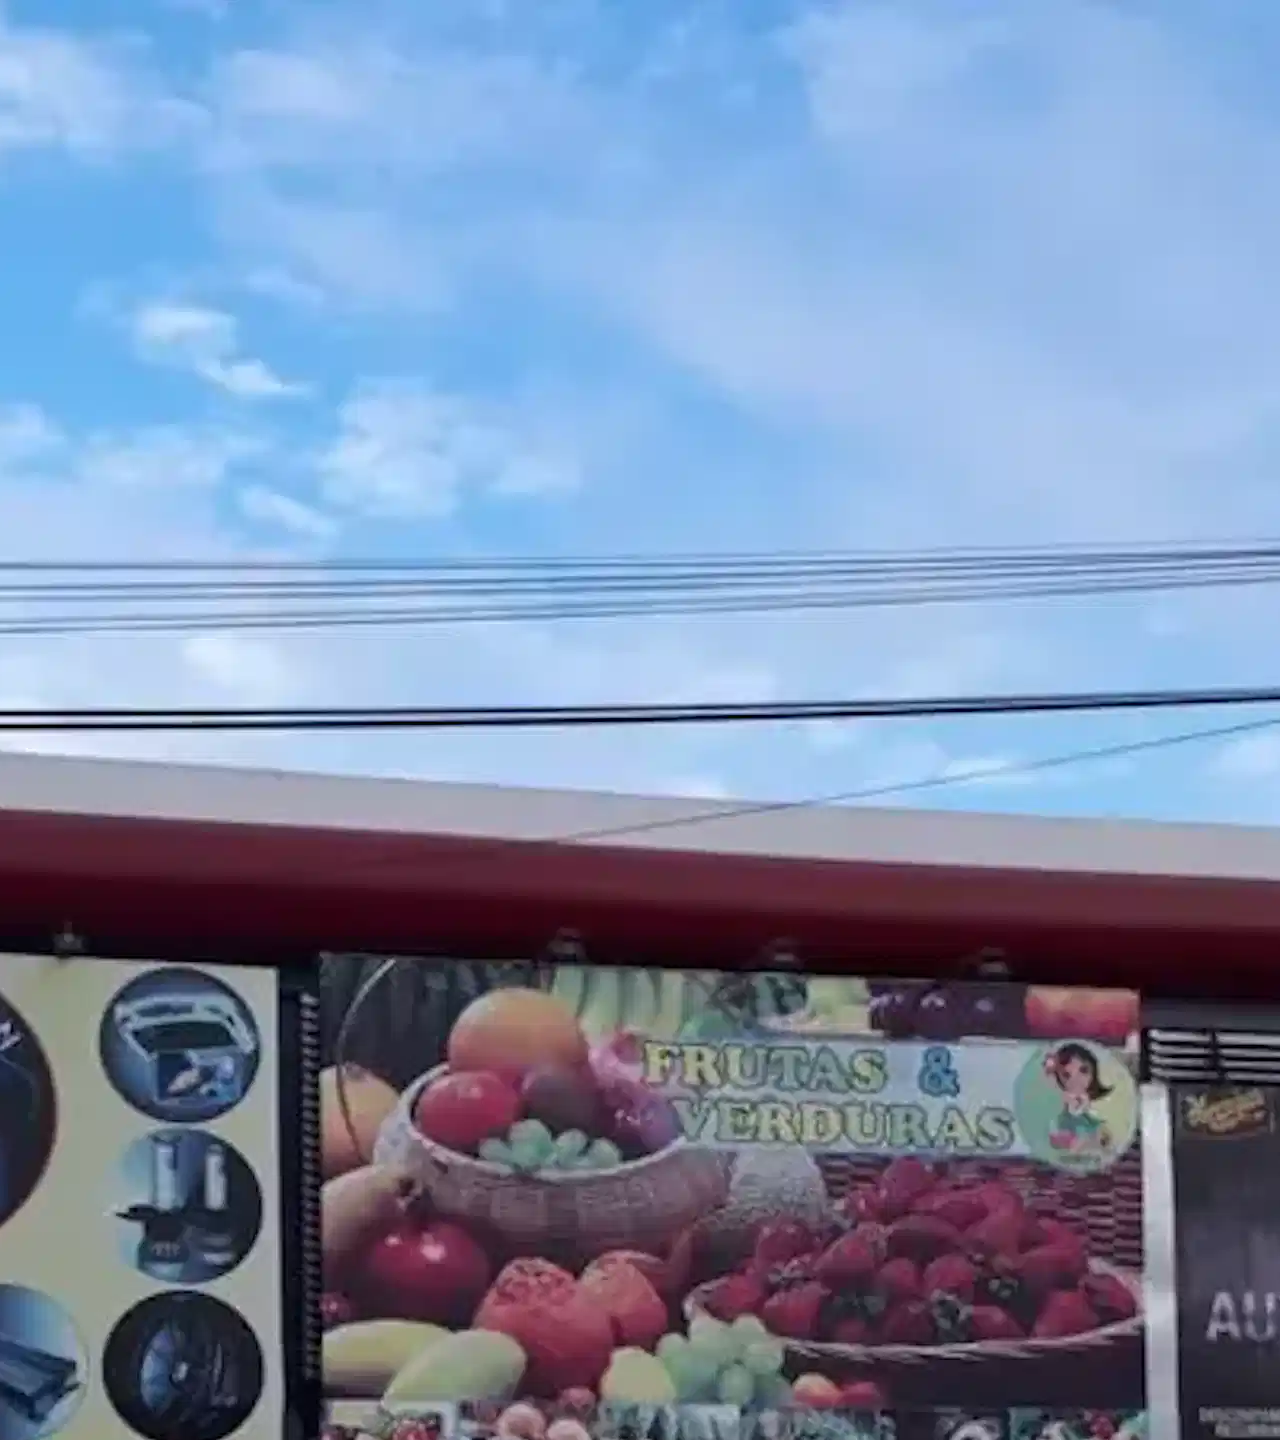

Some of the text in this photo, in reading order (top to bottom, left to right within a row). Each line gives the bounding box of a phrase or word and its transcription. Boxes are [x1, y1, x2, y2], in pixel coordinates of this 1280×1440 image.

[643, 1040, 961, 1098] FRUTAS &
[672, 1098, 1017, 1150] VERDURAS
